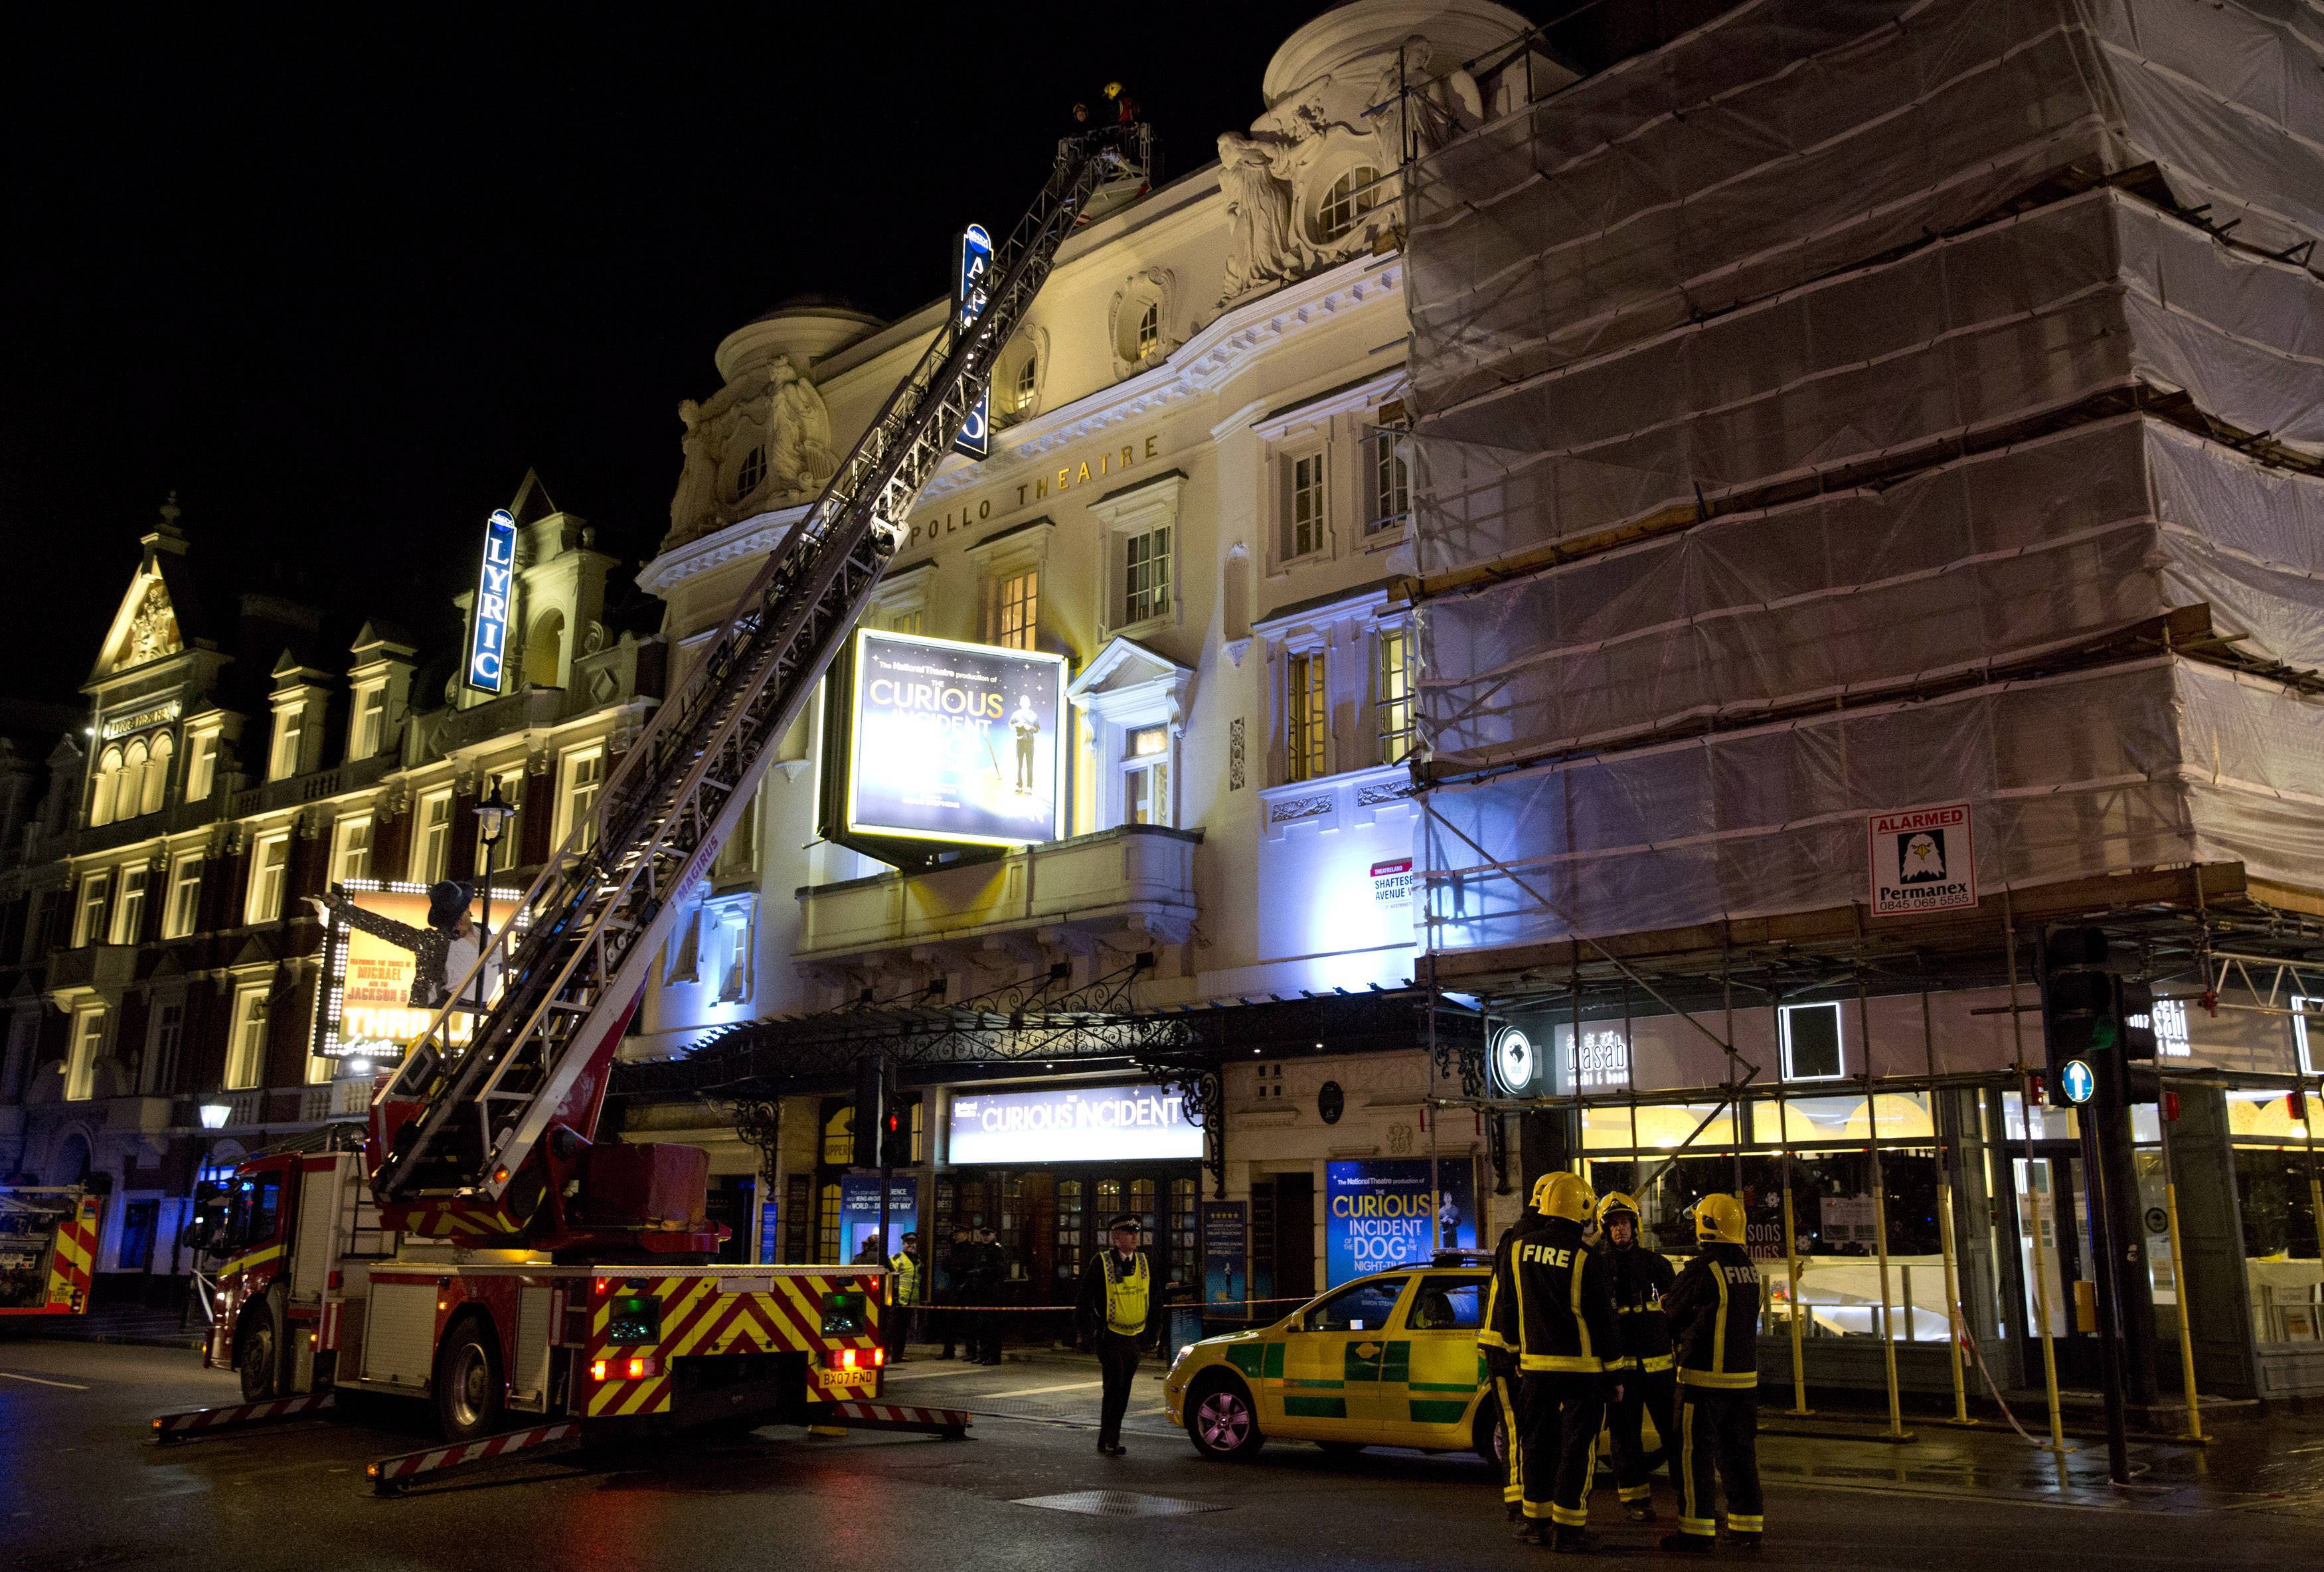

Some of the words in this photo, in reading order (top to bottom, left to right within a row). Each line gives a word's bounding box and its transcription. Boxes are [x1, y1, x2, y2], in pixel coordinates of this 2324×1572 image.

[910, 500, 990, 546] POLLO
[1017, 435, 1158, 505] THEATRE
[475, 537, 509, 678] LYRIC
[893, 662, 924, 673] National
[924, 666, 955, 677] Theatre
[956, 672, 989, 682] production
[870, 678, 1004, 718] CURIOUS
[1877, 809, 1963, 832] ALARMED
[677, 836, 718, 902] MAGIRUS
[1374, 866, 1403, 875] THEATRELAND
[1374, 875, 1412, 890] SHAFTES
[1880, 882, 1967, 901] Permanex
[1376, 888, 1405, 900] AVENUE
[1880, 900, 1910, 911] 0845
[1914, 898, 1936, 908] 069
[1940, 894, 1969, 905] 5555
[357, 966, 401, 981] MICHAEL
[347, 987, 397, 1001] JACKSON
[400, 990, 408, 1002] 5
[1567, 1035, 1626, 1071] wasab
[1606, 1070, 1628, 1084] bent
[982, 1103, 1074, 1131] CURIOUS
[1076, 1095, 1183, 1128] INCIDENT
[1333, 1194, 1432, 1218] CURIOUS
[1349, 1218, 1423, 1238] INCIDENT
[1747, 1223, 1782, 1242] SONS
[1354, 1236, 1407, 1260] DOG
[1523, 1244, 1571, 1269] FIRE
[1724, 1265, 1760, 1285] FIRE
[824, 1372, 850, 1385] BX07
[853, 1372, 872, 1383] FND
